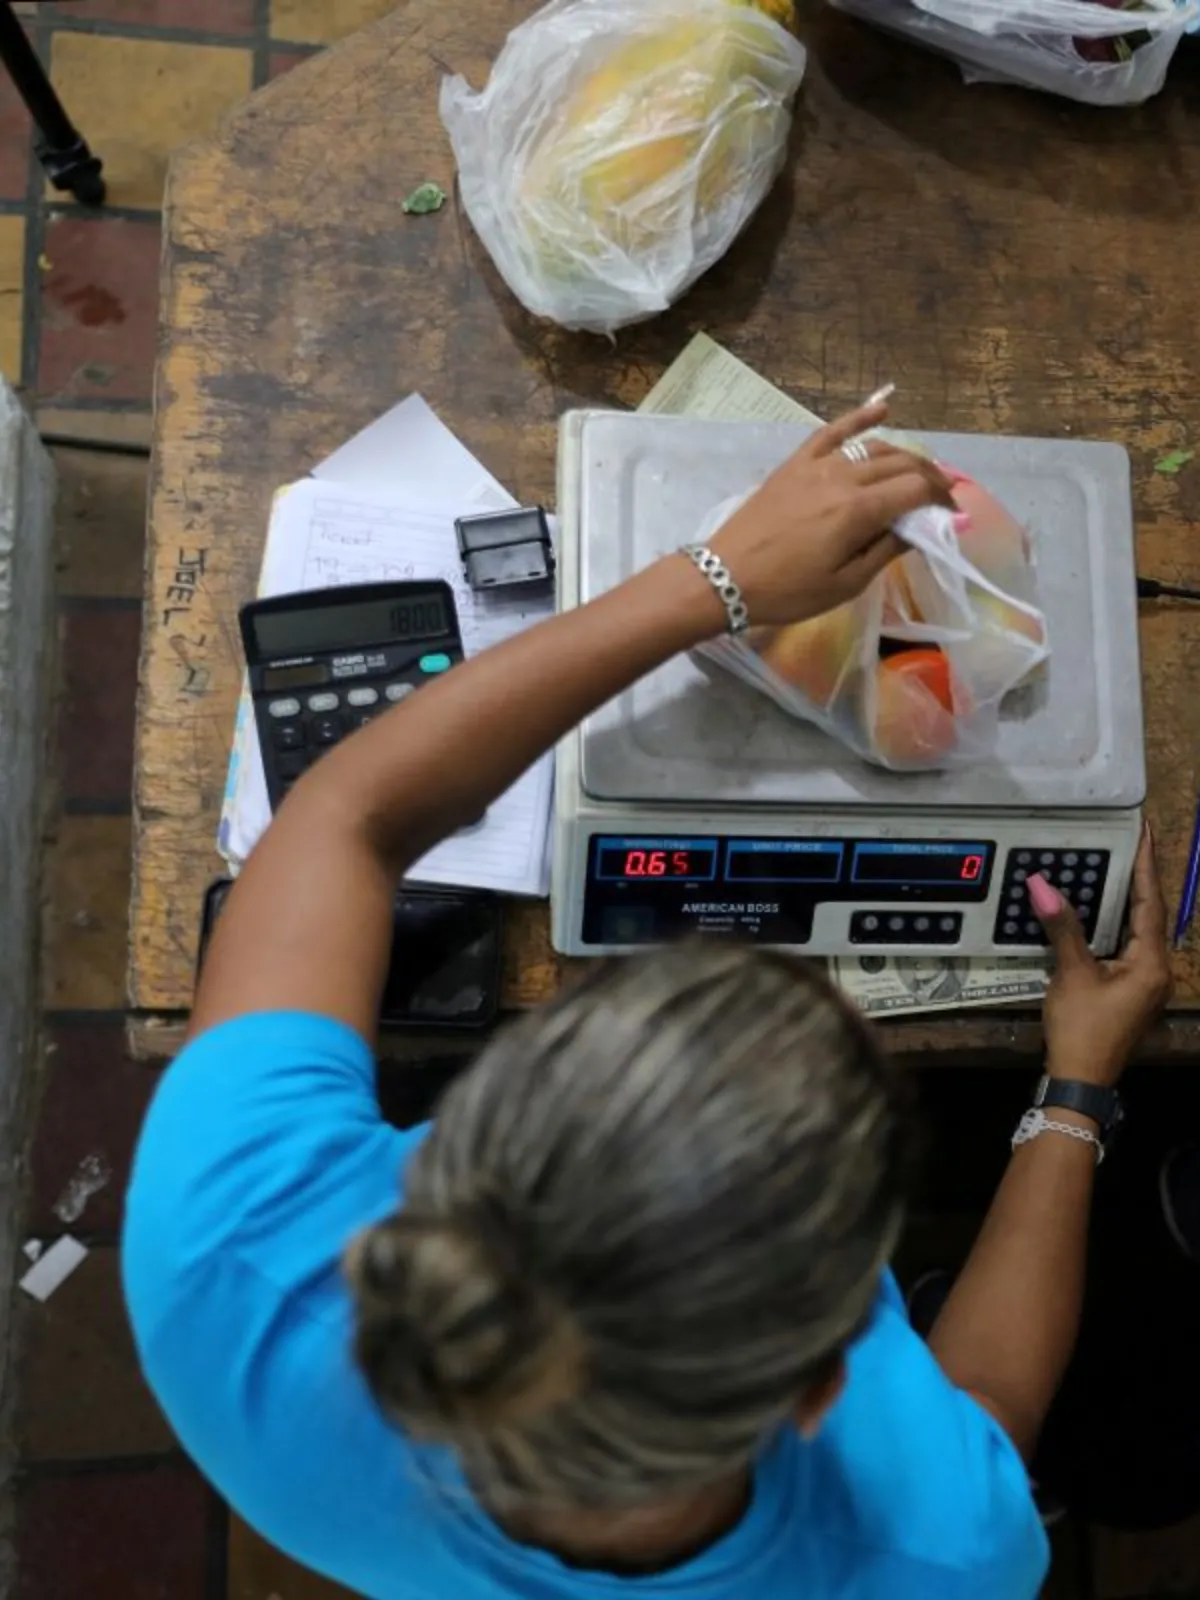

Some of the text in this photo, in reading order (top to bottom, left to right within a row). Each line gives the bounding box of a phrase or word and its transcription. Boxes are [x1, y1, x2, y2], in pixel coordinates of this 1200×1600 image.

[389, 601, 443, 634] 1800
[961, 855, 983, 879] 0
[681, 902, 780, 914] AMERICAN BOSS
